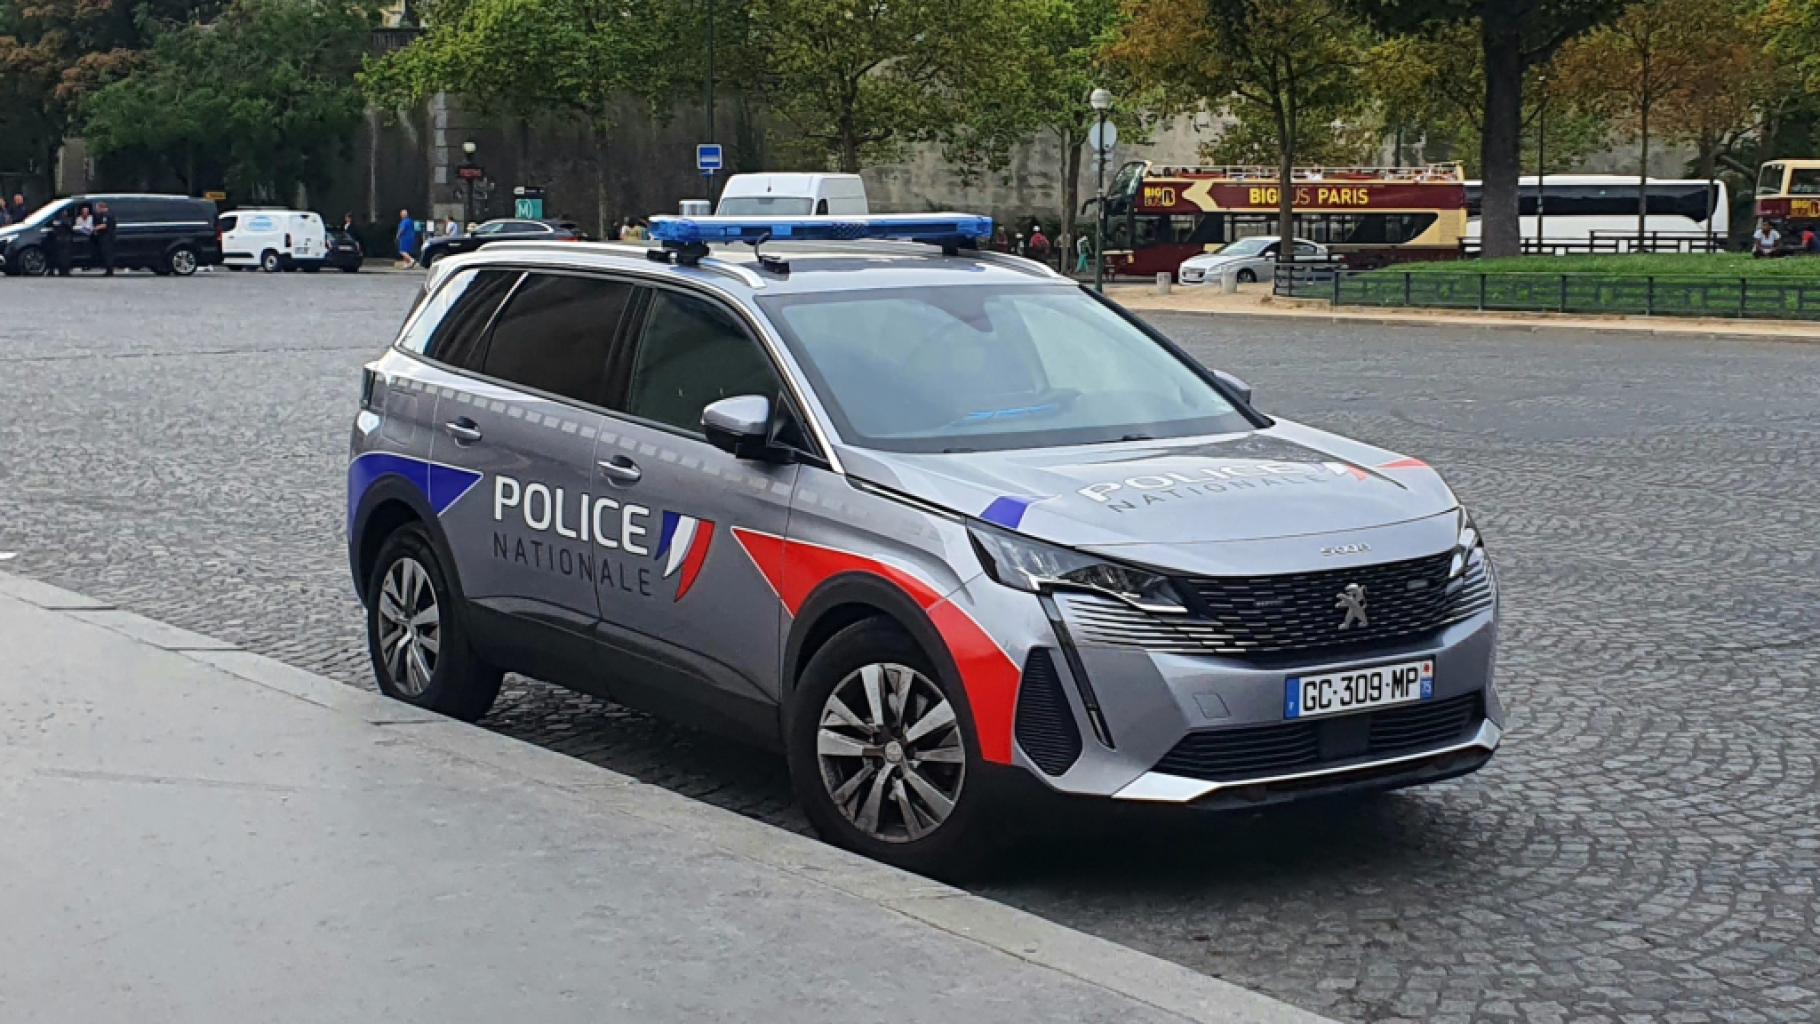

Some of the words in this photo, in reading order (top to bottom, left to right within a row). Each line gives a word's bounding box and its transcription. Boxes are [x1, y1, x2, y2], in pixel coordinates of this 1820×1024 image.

[1318, 187, 1370, 205] PARIS
[1077, 463, 1297, 502] POLICE
[493, 475, 650, 555] POLICE
[493, 532, 653, 596] NATIONALE
